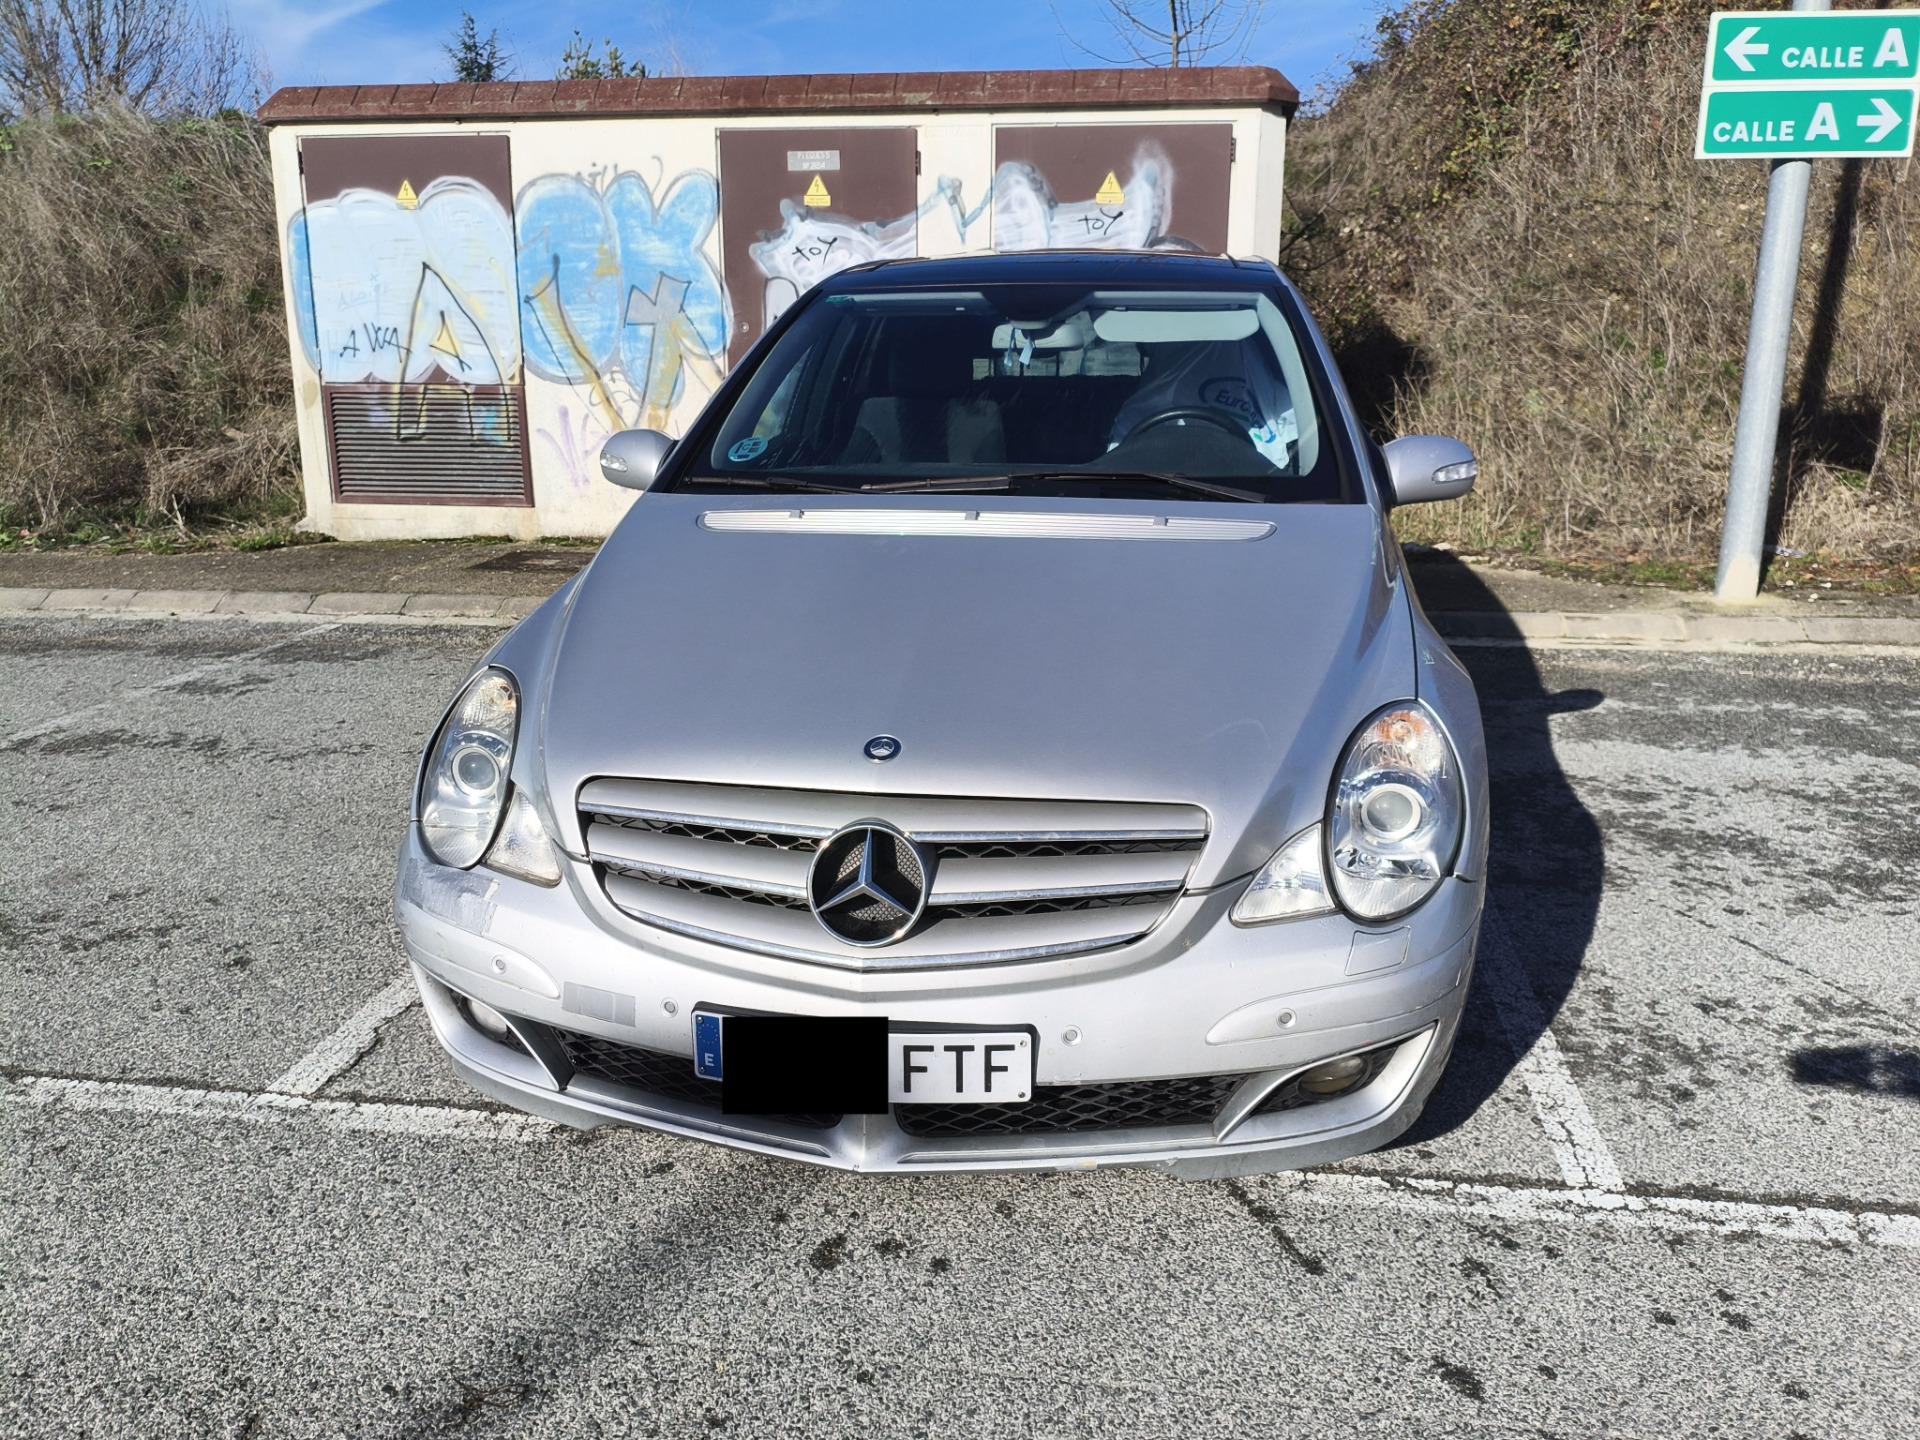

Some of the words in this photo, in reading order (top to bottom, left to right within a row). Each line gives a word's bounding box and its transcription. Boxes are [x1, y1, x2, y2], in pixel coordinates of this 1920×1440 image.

[1781, 46, 1864, 68] CALLE
[1873, 27, 1910, 68] A
[1712, 120, 1796, 143] CALLE
[1804, 101, 1841, 141] A
[704, 1053, 715, 1067] E
[902, 1044, 1016, 1094] FTF
